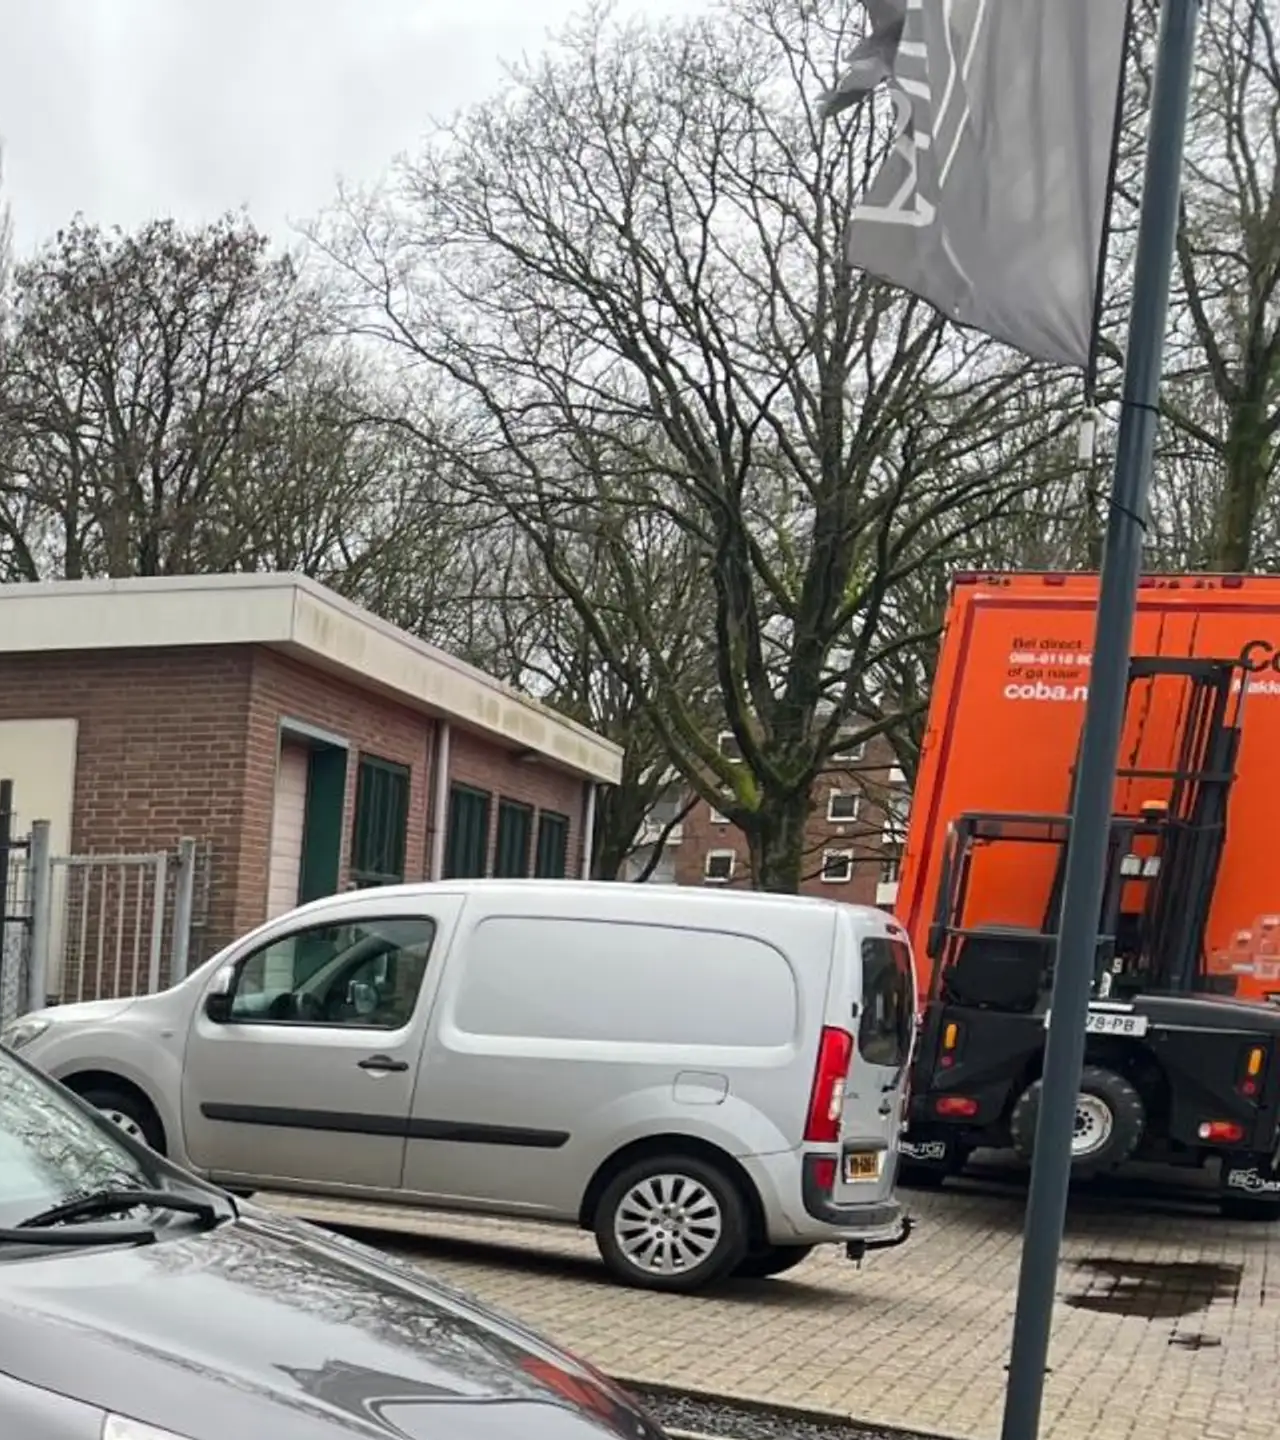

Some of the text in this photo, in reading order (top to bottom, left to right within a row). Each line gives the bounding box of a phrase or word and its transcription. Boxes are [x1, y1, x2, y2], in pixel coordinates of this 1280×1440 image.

[1040, 639, 1082, 650] direct
[1007, 667, 1022, 677] of
[1004, 681, 1088, 701] coba.n
